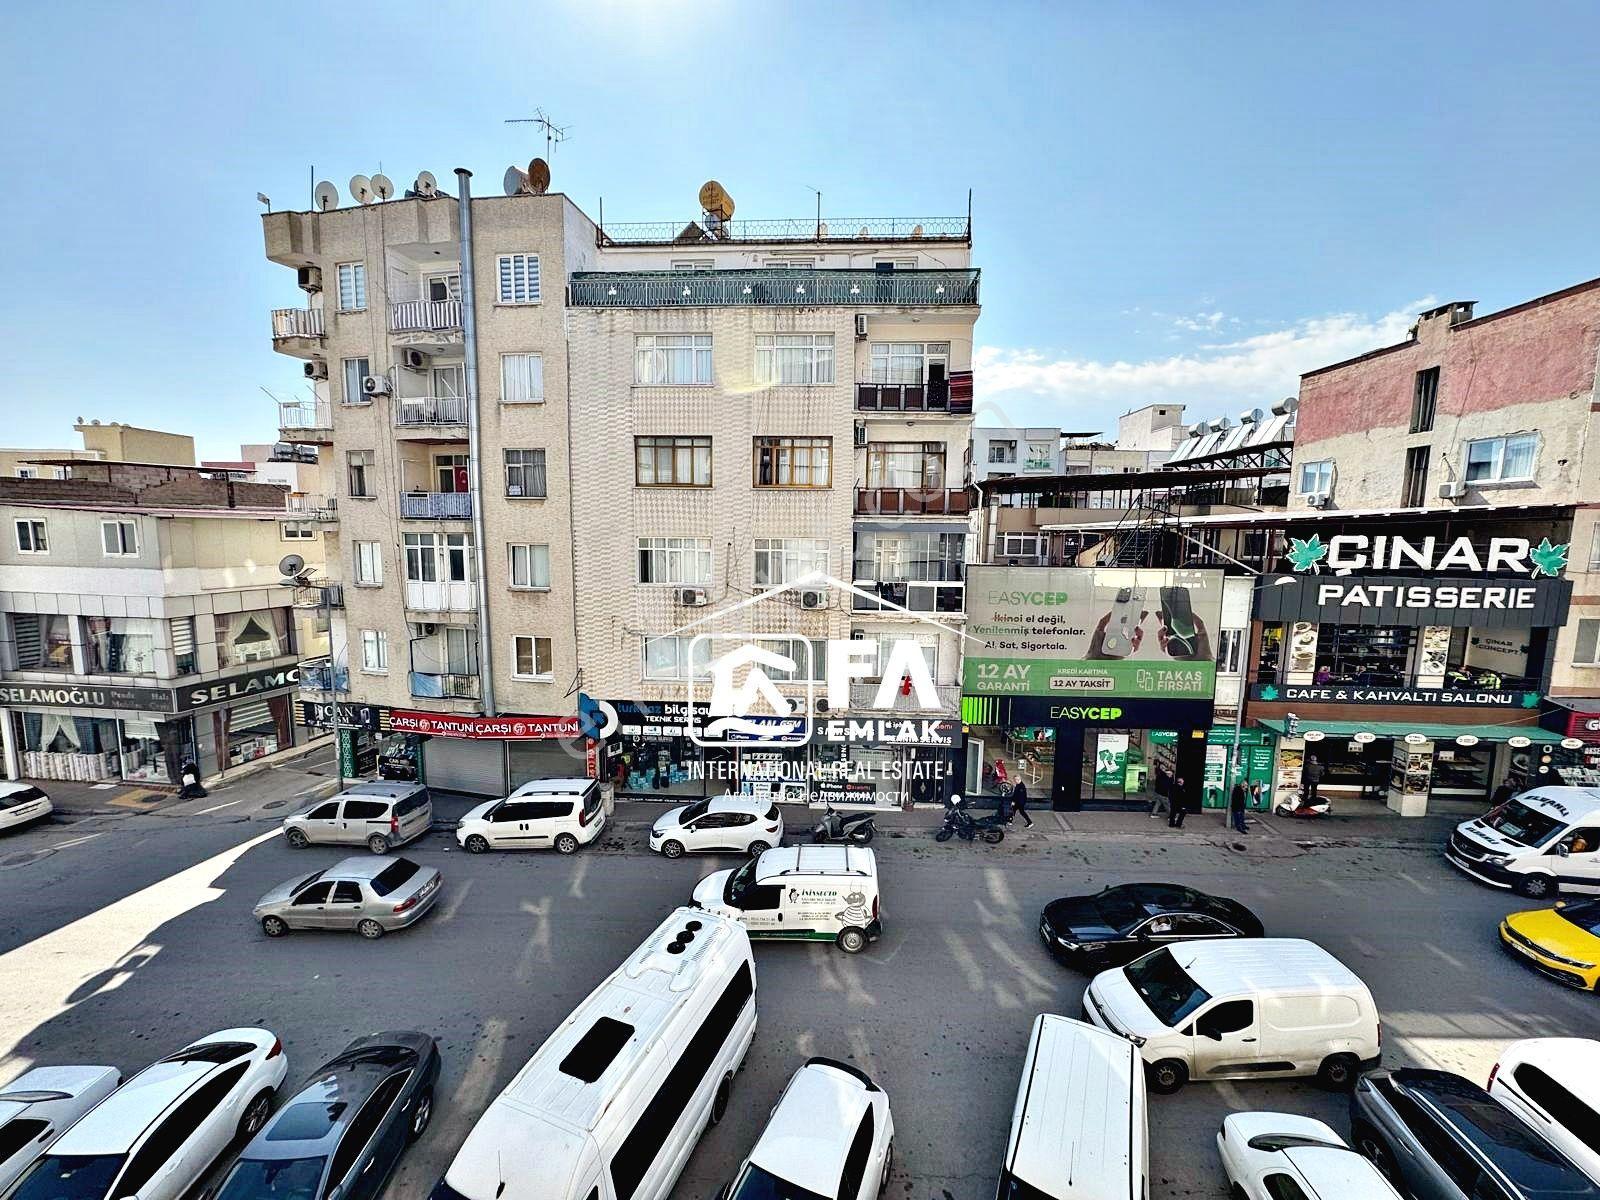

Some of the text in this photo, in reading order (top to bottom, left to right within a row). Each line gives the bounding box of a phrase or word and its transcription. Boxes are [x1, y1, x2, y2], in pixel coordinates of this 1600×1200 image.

[1328, 535, 1530, 576] ÇINAR
[988, 591, 1068, 605] EASYCEP
[1318, 585, 1536, 608] PATISSERIE
[978, 664, 1031, 679] 12 AY
[1157, 671, 1203, 681] TAKAS
[976, 680, 1031, 692] GARANTİ
[1080, 679, 1112, 688] TAKSİT
[1286, 689, 1513, 704] CAFE & KAHVALTI SALONU
[1050, 706, 1122, 719] EASYCEP
[389, 717, 418, 729] ÇARŞI
[431, 720, 474, 732] TANTUNİ
[475, 723, 511, 735] ÇARŞI
[527, 721, 579, 732] TANTUNİ
